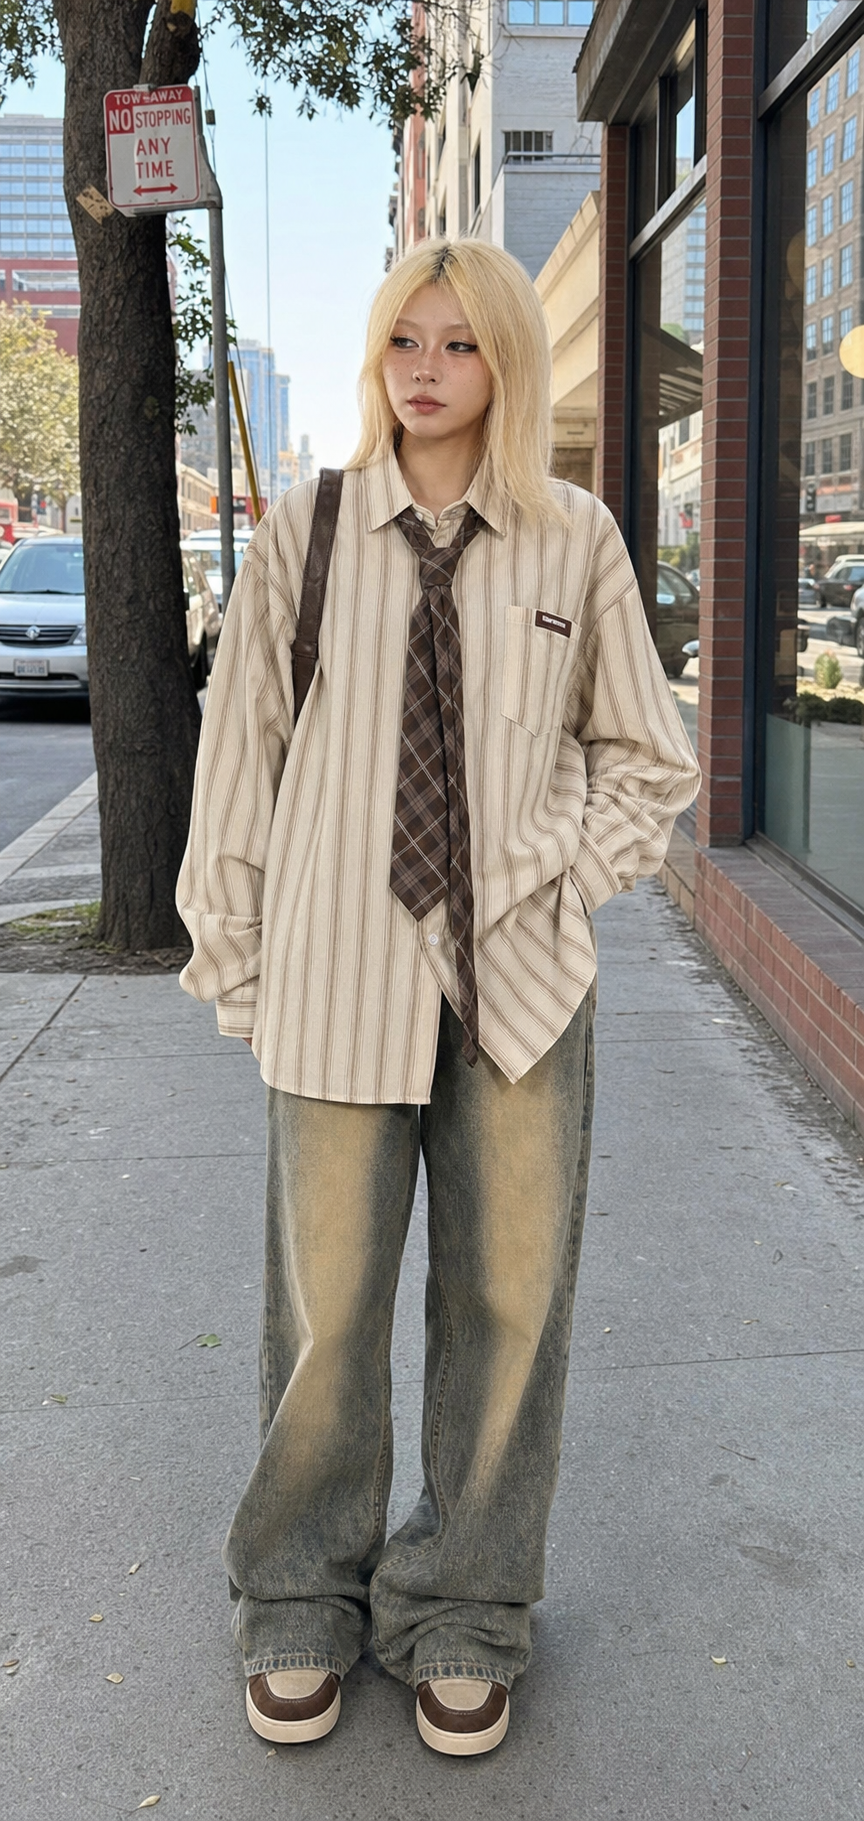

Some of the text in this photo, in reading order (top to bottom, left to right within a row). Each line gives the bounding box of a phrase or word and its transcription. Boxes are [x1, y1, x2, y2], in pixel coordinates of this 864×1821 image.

[109, 108, 191, 132] NO STOPPING
[136, 137, 171, 156] ANY
[135, 160, 174, 179] TIME
